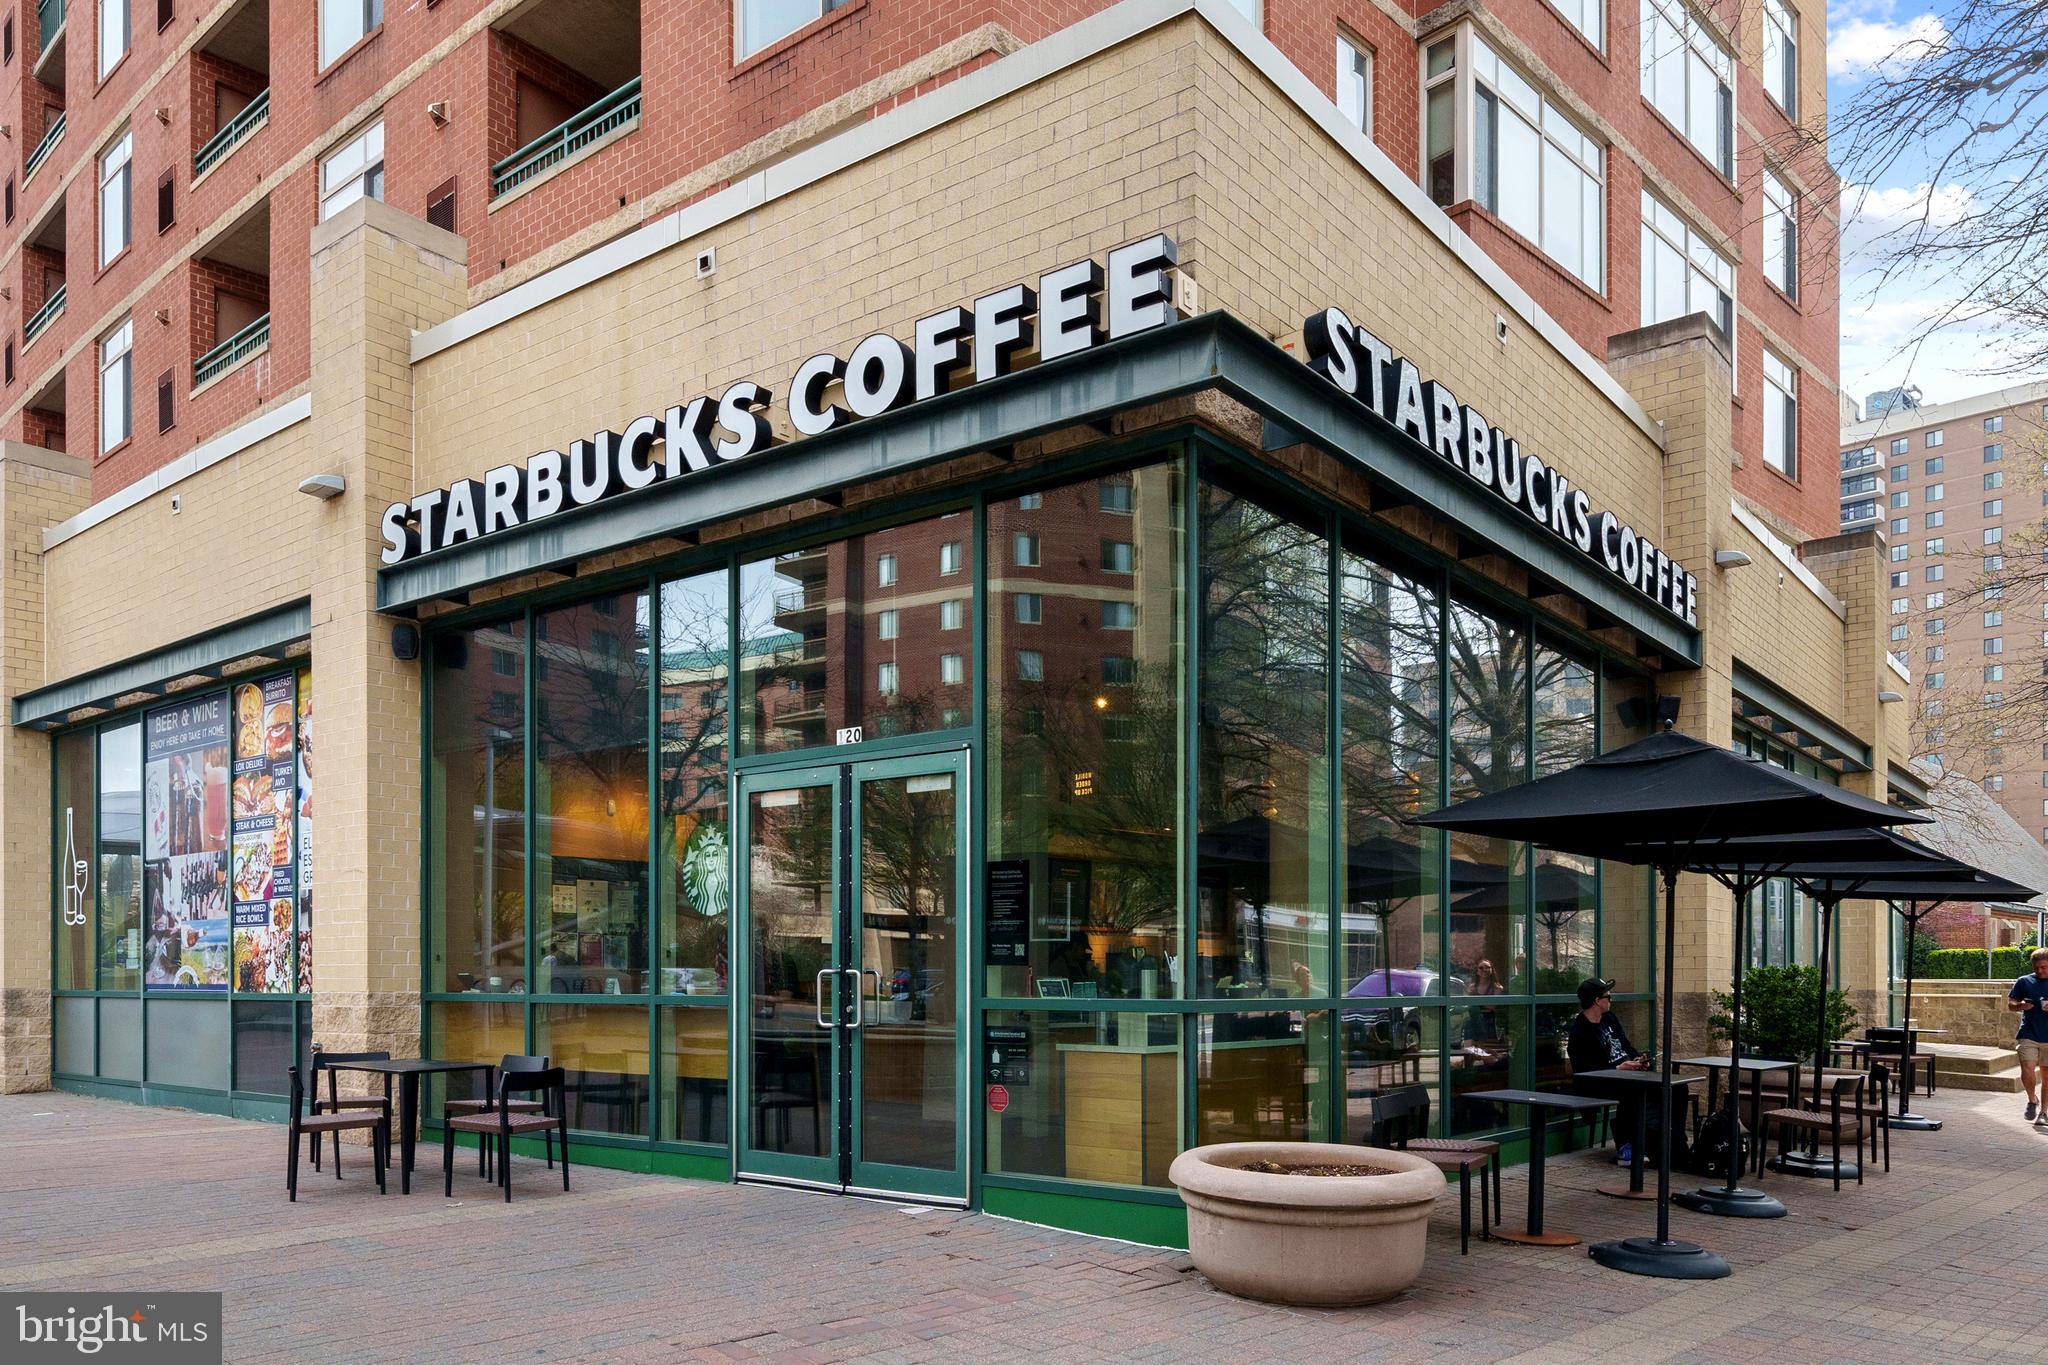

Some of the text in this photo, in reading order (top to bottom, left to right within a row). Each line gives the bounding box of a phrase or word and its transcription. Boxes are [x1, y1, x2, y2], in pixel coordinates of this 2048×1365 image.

[380, 231, 1178, 566] STARBUCKS COFFEE
[1304, 306, 1698, 627] STARBUCKS COFFEE
[265, 676, 292, 691] BREAKFAST
[265, 688, 286, 702] BURRITO
[155, 700, 219, 734] BEER & WINE
[150, 723, 225, 751] ENJOY HERE OR TAKE IT HOME
[245, 758, 264, 770] DELUXE
[274, 766, 293, 777] TURKEY
[275, 777, 286, 787] AVO
[235, 817, 274, 831] STEAK & CHEESE
[274, 870, 285, 878] FRIED
[274, 877, 291, 886] CHICKEN
[235, 903, 267, 914] WARM MIXED
[235, 913, 264, 924] RICE BOWLS
